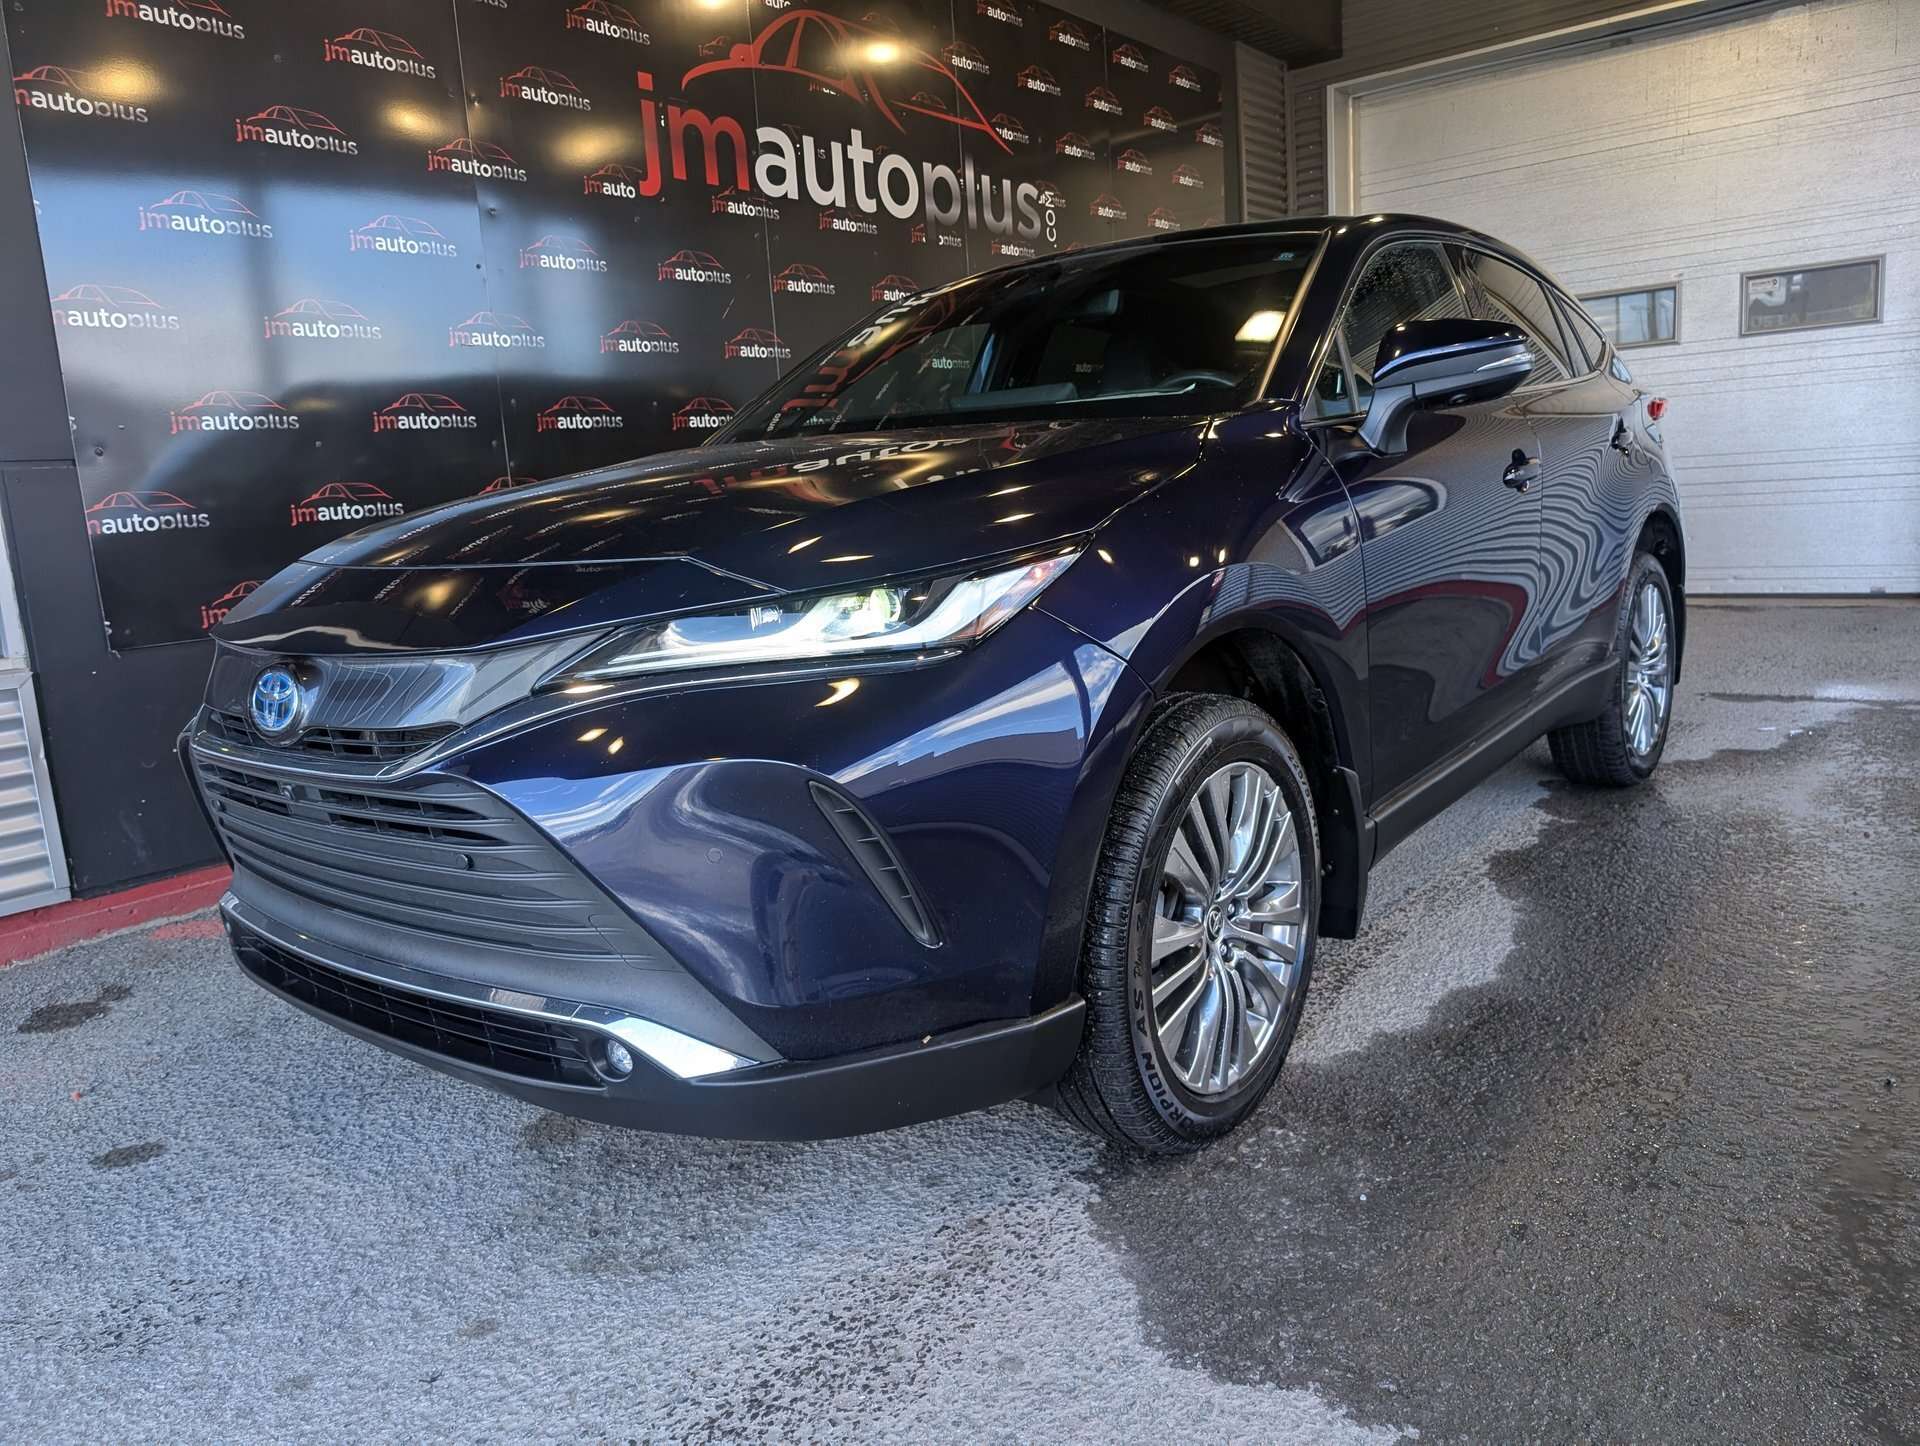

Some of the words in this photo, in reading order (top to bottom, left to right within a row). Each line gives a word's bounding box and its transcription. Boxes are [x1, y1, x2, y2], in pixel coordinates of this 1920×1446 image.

[105, 0, 246, 40] jmautoplus
[565, 9, 650, 46] jmautoplus
[324, 39, 436, 79] jmautoplus
[14, 87, 149, 123] mautoplus
[500, 77, 592, 112] jmautoplus
[234, 119, 359, 156] jmautoplus
[427, 150, 528, 183] jmautoplus
[636, 70, 1041, 241] jmautoplus
[583, 175, 636, 199] jmauto
[712, 196, 780, 221] jmautoplus
[138, 207, 273, 240] jmautoplus
[819, 214, 878, 236] jmautoplus
[350, 230, 457, 258] jmautoplus
[519, 247, 608, 273] jmautoplus
[657, 262, 732, 285] jmautoplus
[772, 275, 836, 296] jmautoplus
[51, 307, 181, 331] mautoplus
[263, 315, 383, 341] jmautoplus
[448, 326, 545, 349] jmautoplus
[600, 335, 680, 354] jmautoplus
[724, 341, 792, 361] jmautoplus
[169, 410, 301, 435] jmautoplus
[372, 410, 478, 433] jmautoplus
[536, 411, 624, 433] jmautoplus
[86, 511, 211, 536] mautoplus
[290, 500, 405, 528] jmautoplus
